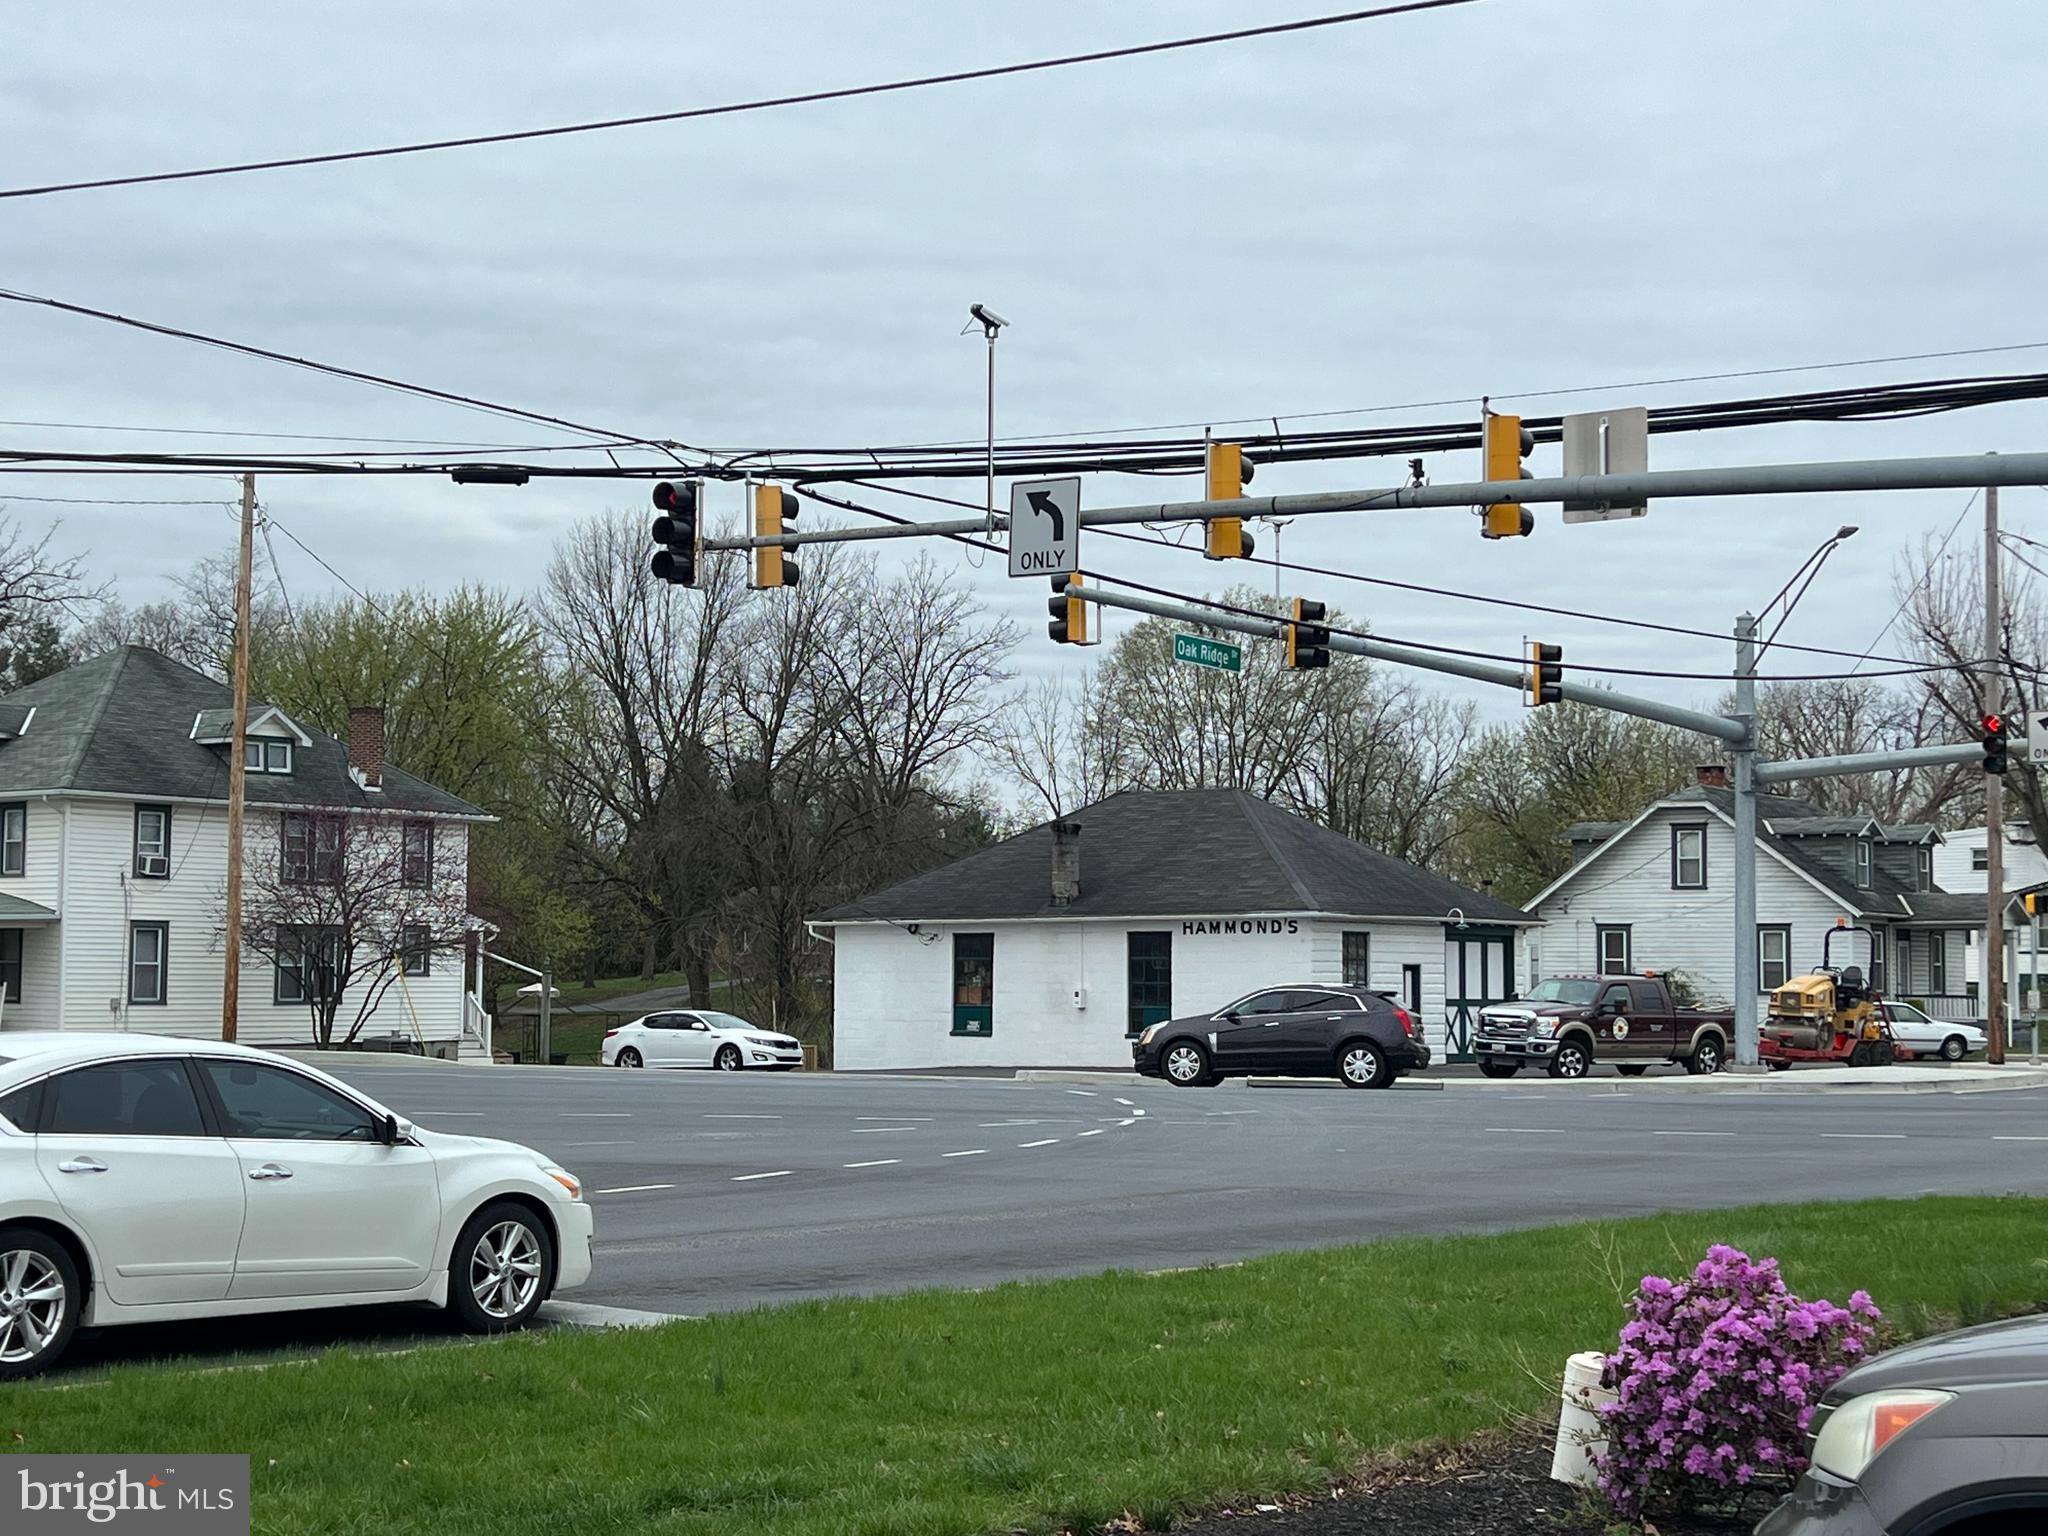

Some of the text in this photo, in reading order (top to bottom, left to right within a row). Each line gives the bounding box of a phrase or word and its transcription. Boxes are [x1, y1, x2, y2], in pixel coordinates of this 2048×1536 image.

[1021, 549, 1065, 570] ONLY
[1177, 639, 1197, 658] Oak
[1200, 644, 1229, 668] Ridge
[1182, 918, 1299, 935] HAMMOND'S
